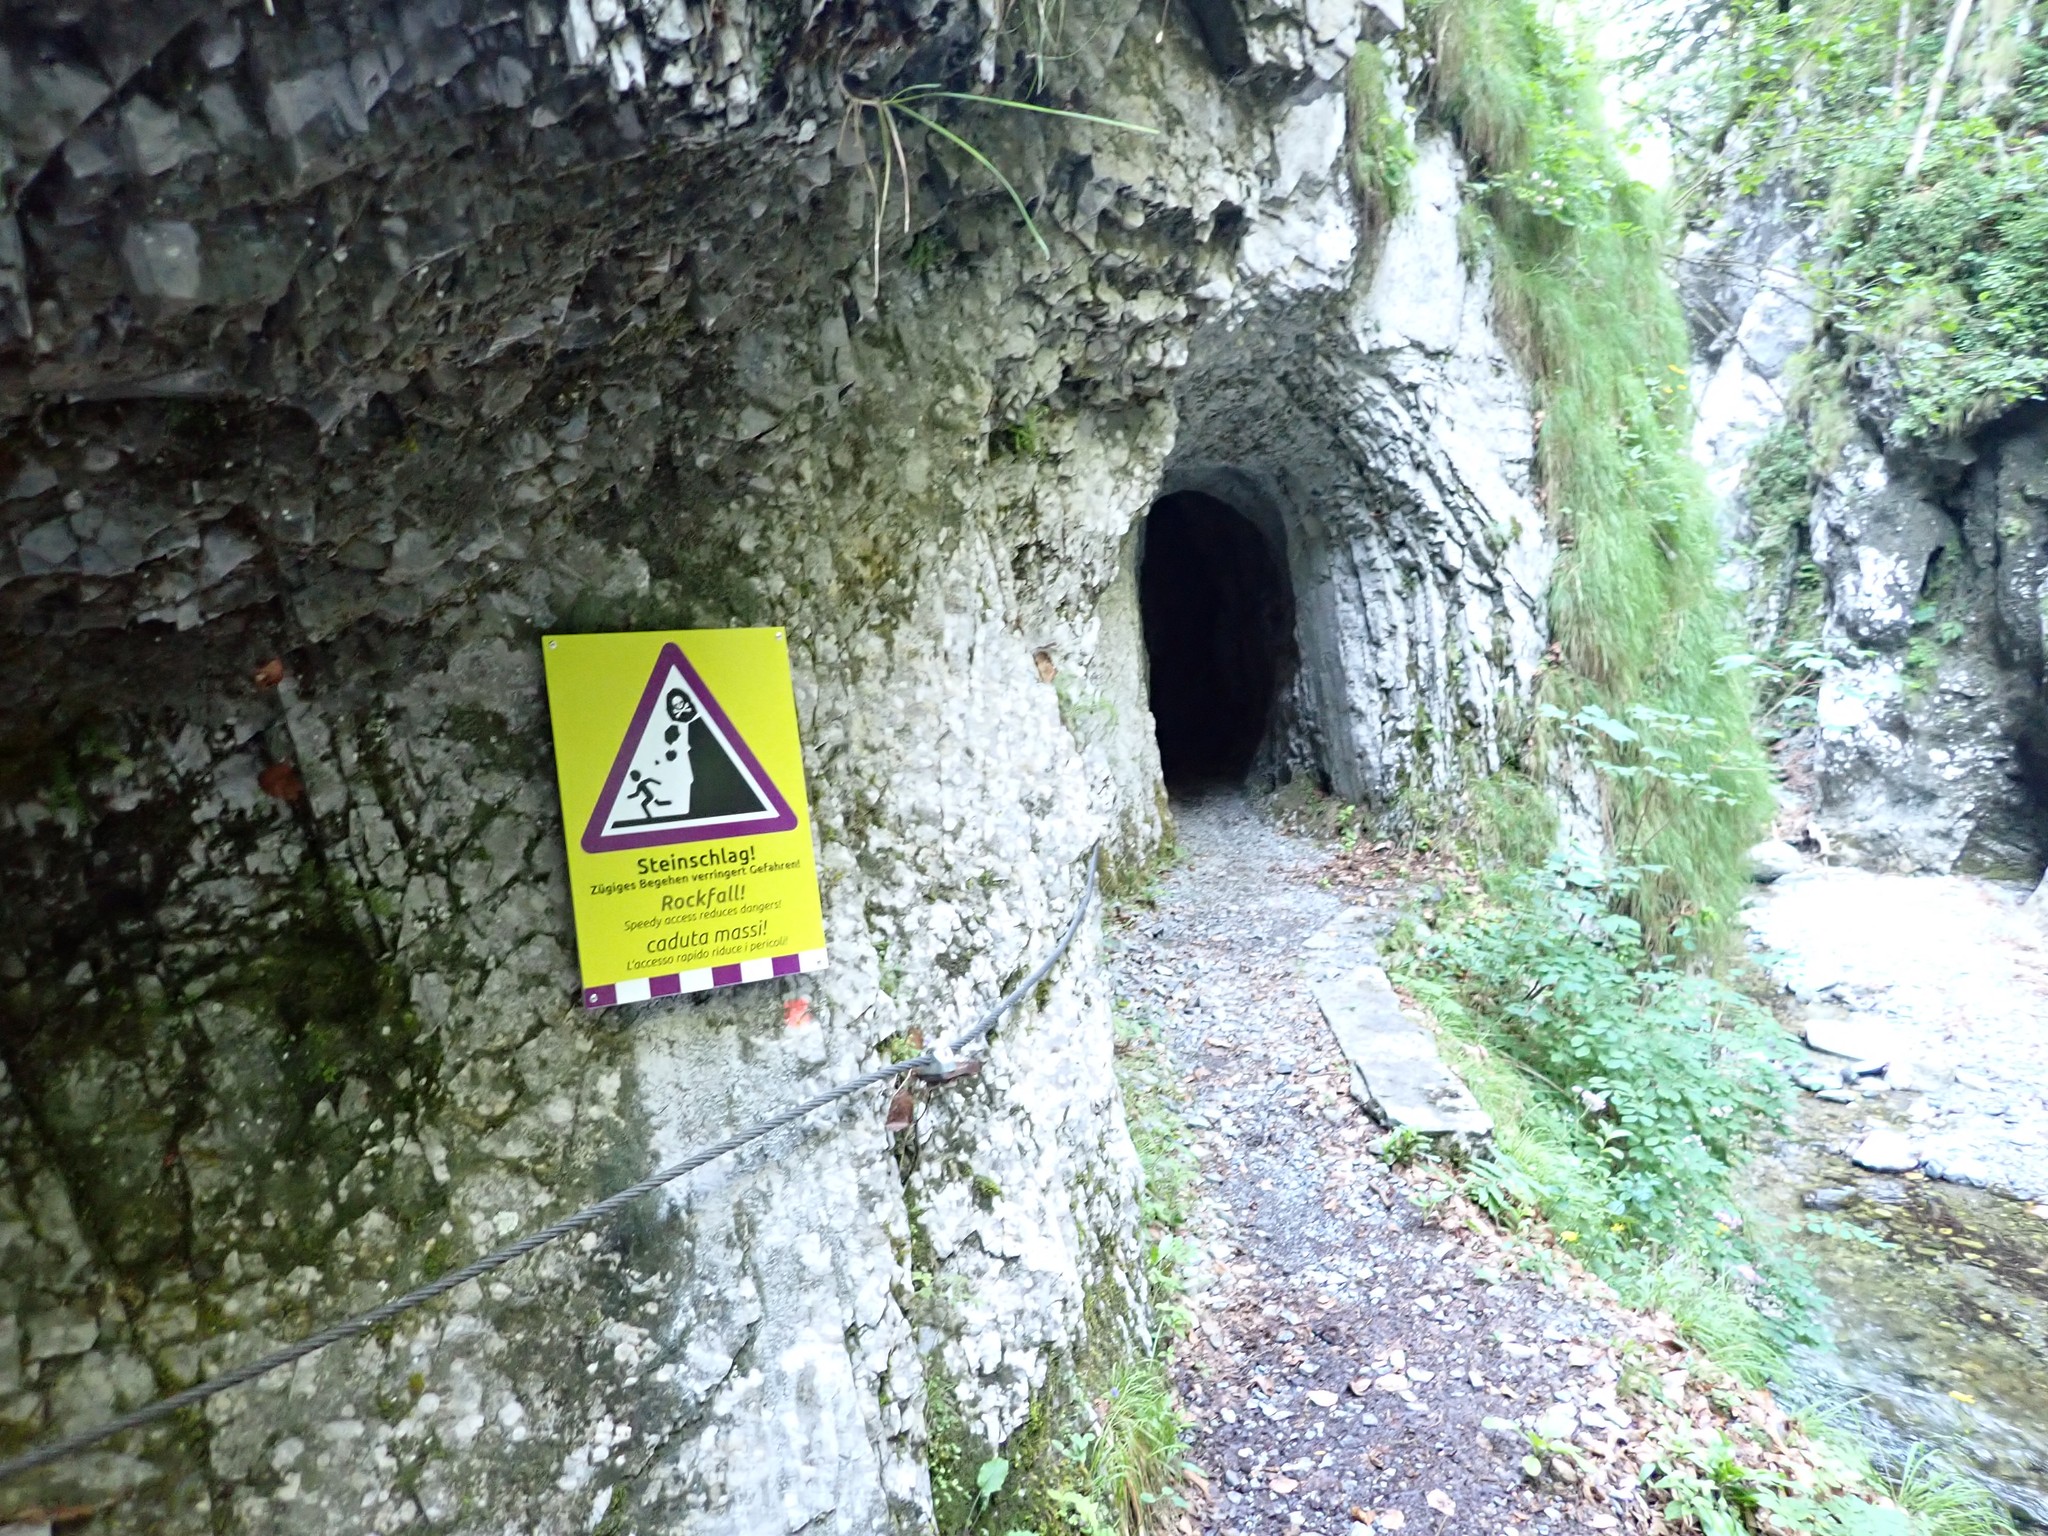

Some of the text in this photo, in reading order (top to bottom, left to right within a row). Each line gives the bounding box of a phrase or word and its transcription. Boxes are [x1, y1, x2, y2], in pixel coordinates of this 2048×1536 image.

[638, 846, 755, 875] Steinschlag!
[591, 882, 636, 895] Zügiges
[639, 874, 688, 889] Begehen
[692, 867, 747, 882] verringert
[661, 885, 746, 911] Rockfall!
[624, 900, 782, 931] Speedy access reduces dangers!
[647, 920, 768, 953] caduta massi!
[676, 949, 709, 965] rapido
[712, 944, 742, 957] riduce
[745, 944, 748, 952] i
